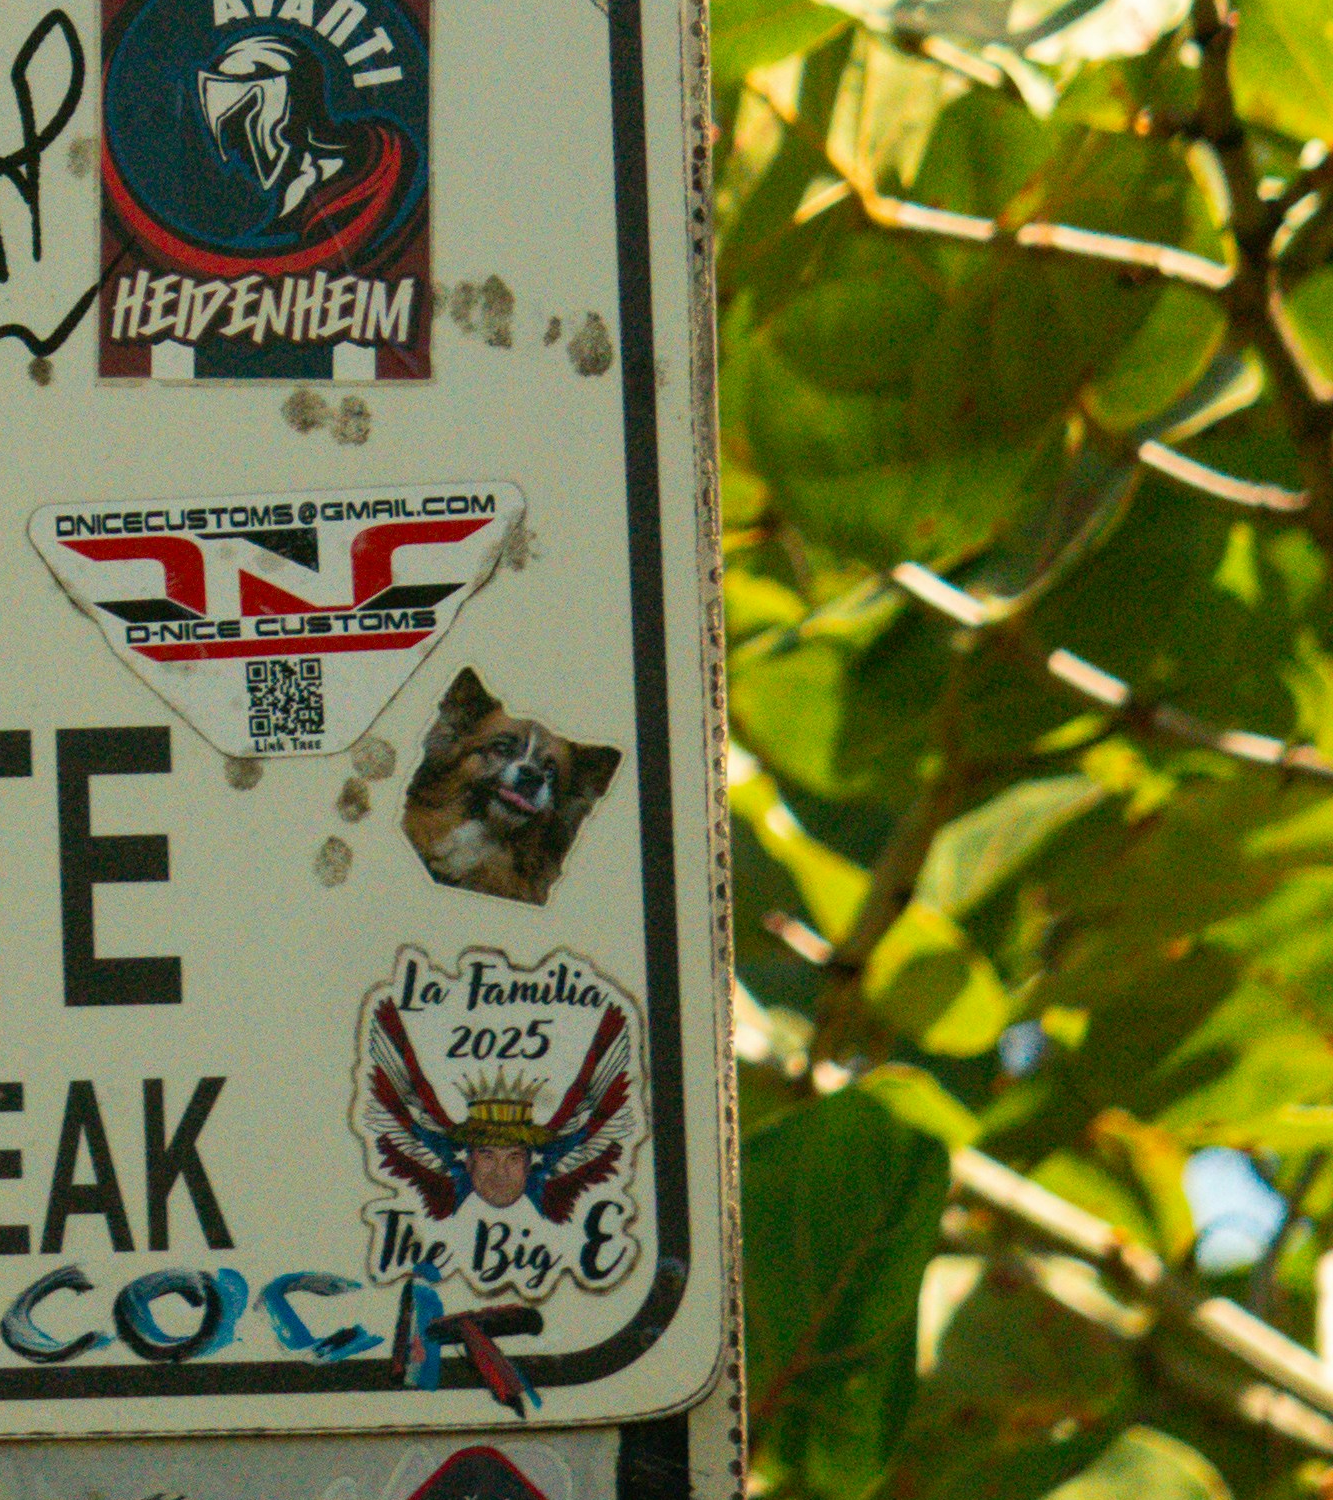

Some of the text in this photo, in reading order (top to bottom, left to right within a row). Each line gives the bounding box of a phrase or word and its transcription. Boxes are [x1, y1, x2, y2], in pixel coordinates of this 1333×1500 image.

[110, 269, 416, 345] HEIDENHEIM
[54, 494, 496, 538] DNICECUSTOMS@GMAIL.COM
[125, 609, 438, 645] D-NICE CUSTOMS
[398, 959, 609, 1012] La Familia
[445, 1019, 555, 1060] 2025
[376, 1201, 628, 1290] The Big E
